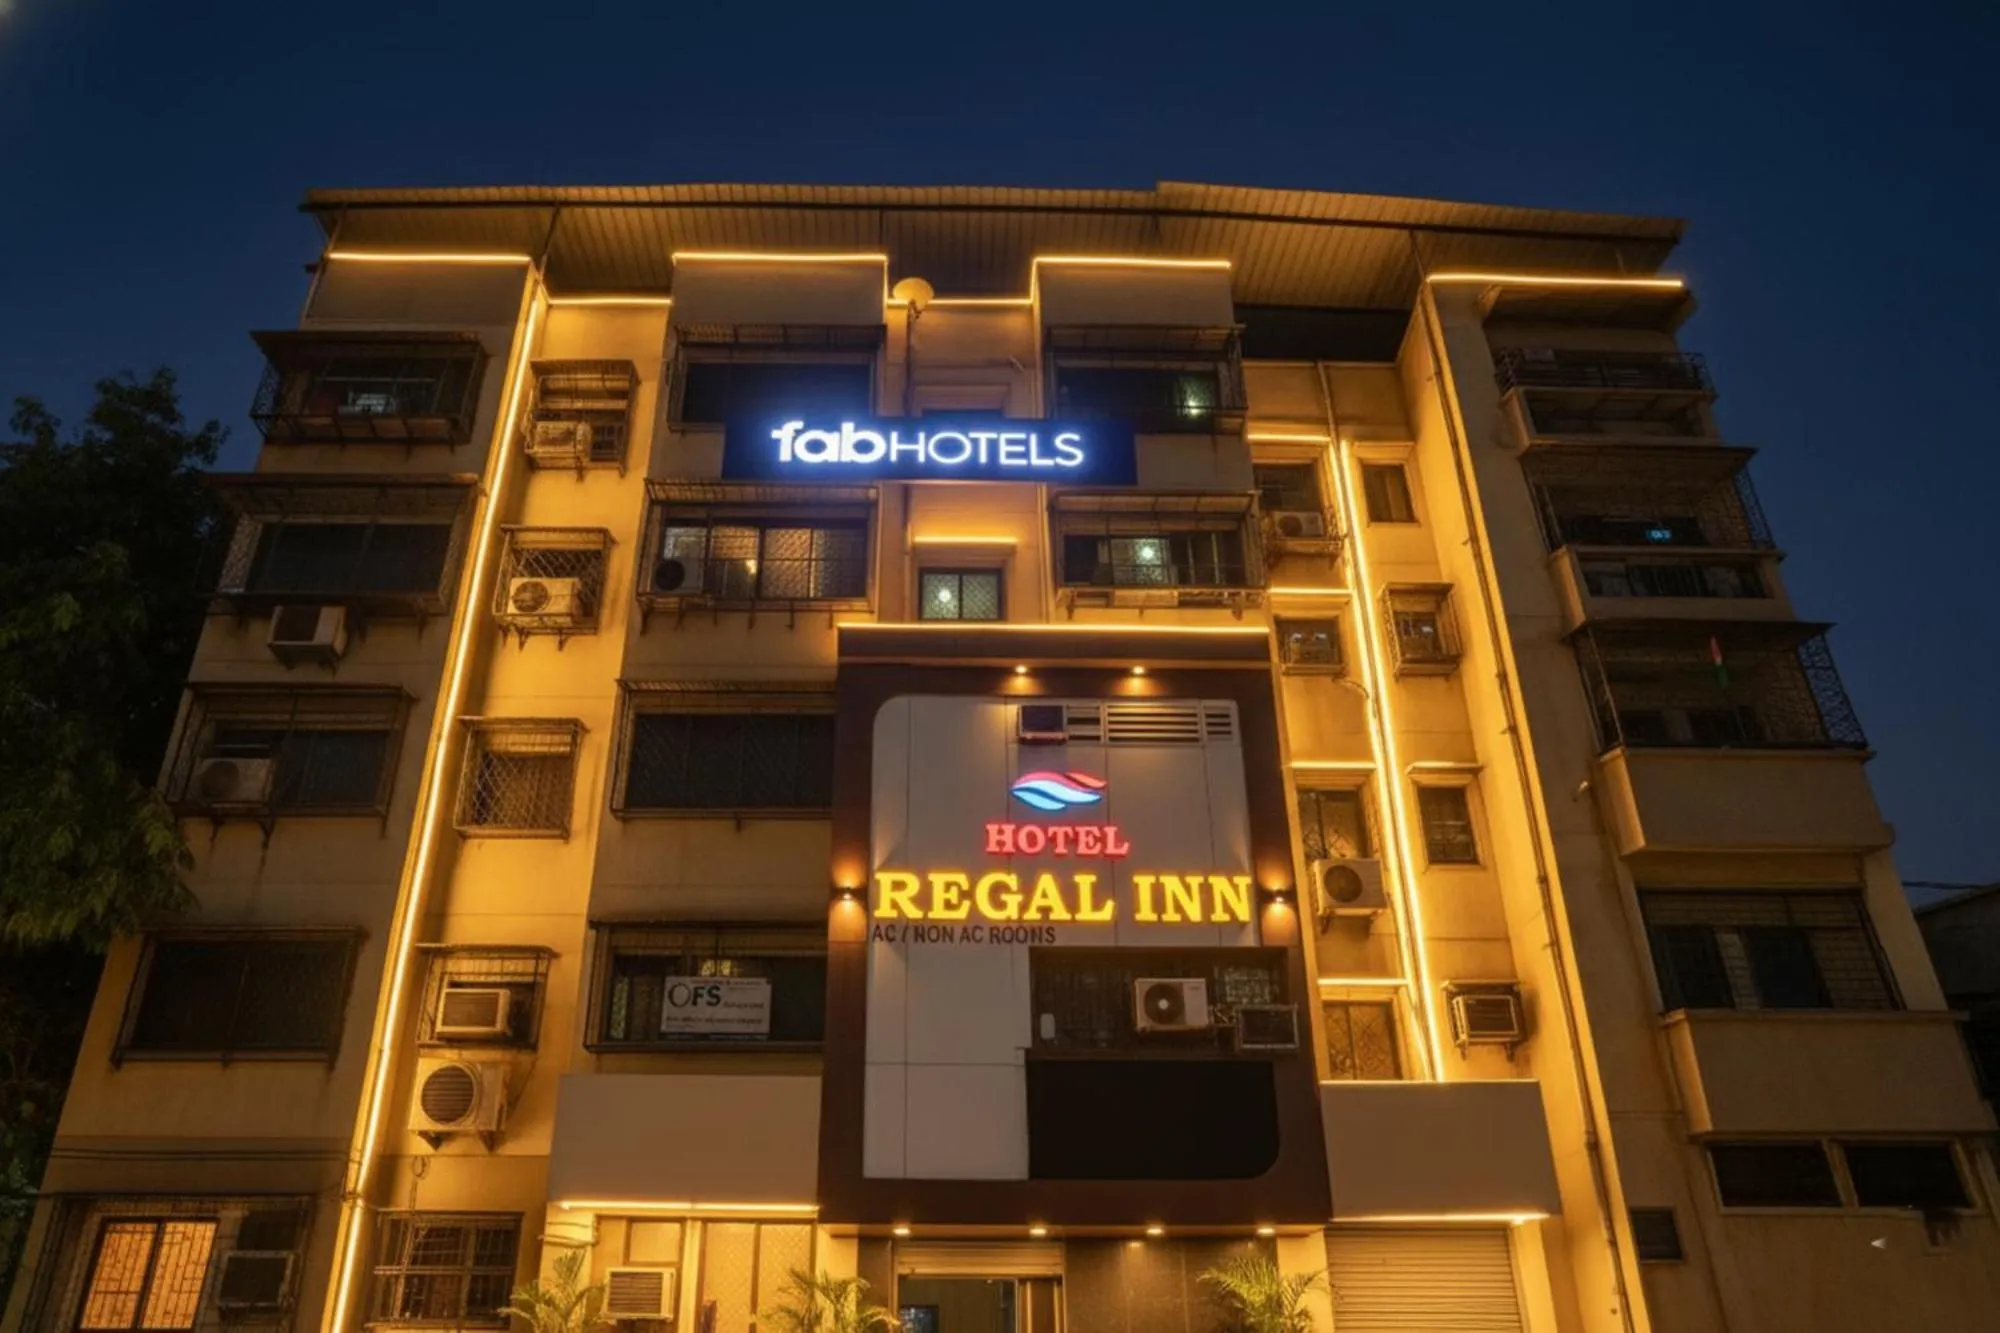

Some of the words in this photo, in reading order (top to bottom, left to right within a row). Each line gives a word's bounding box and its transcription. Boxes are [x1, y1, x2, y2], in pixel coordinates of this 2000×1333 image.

[985, 823, 1131, 856] HOTEL
[873, 872, 1117, 922] REGAL
[1132, 875, 1253, 923] INN
[872, 924, 896, 943] AC
[960, 925, 984, 944] AC
